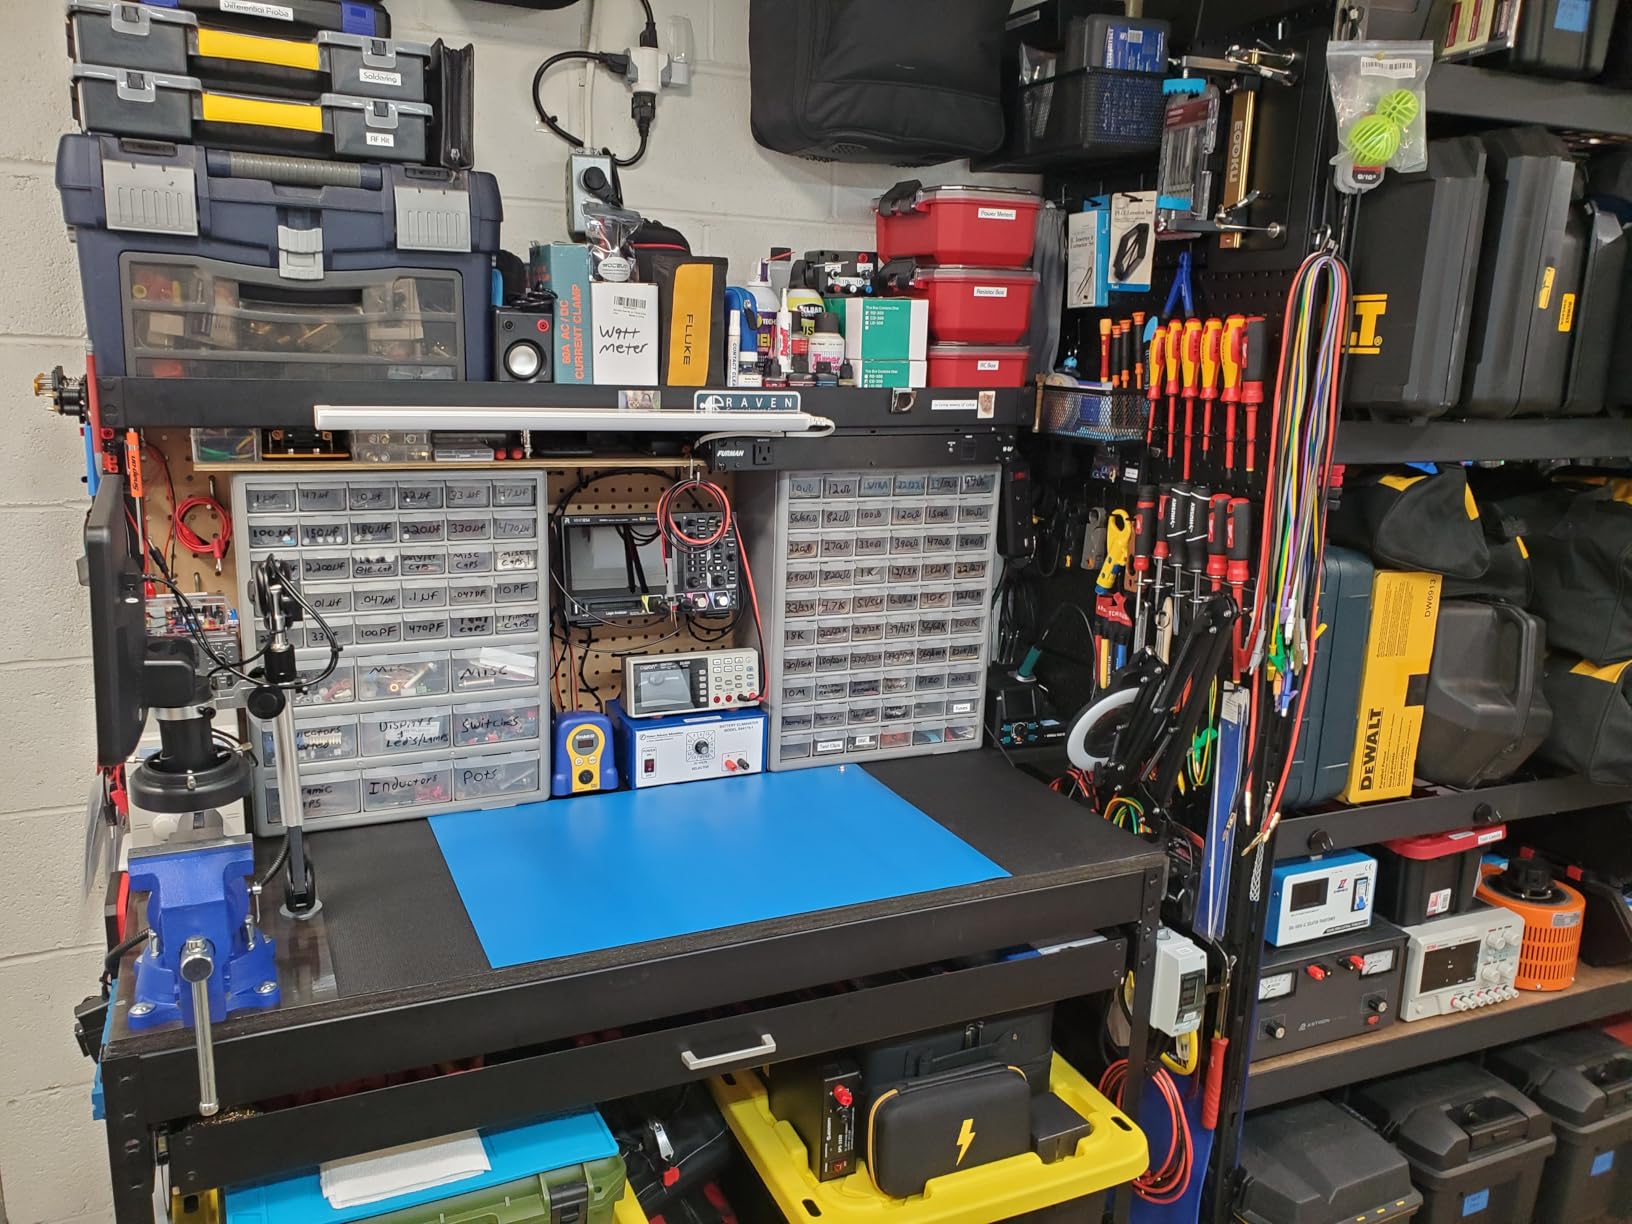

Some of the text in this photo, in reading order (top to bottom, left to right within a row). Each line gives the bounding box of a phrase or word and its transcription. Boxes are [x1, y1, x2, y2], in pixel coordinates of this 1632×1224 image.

[363, 71, 398, 84] Soldering
[572, 284, 584, 380] CURRENT CLAMP
[599, 325, 641, 340] Watt
[683, 314, 694, 366] FLUKE
[726, 397, 792, 408] RAVEN
[1360, 708, 1382, 791] DEWALT
[463, 769, 497, 784] Pots
